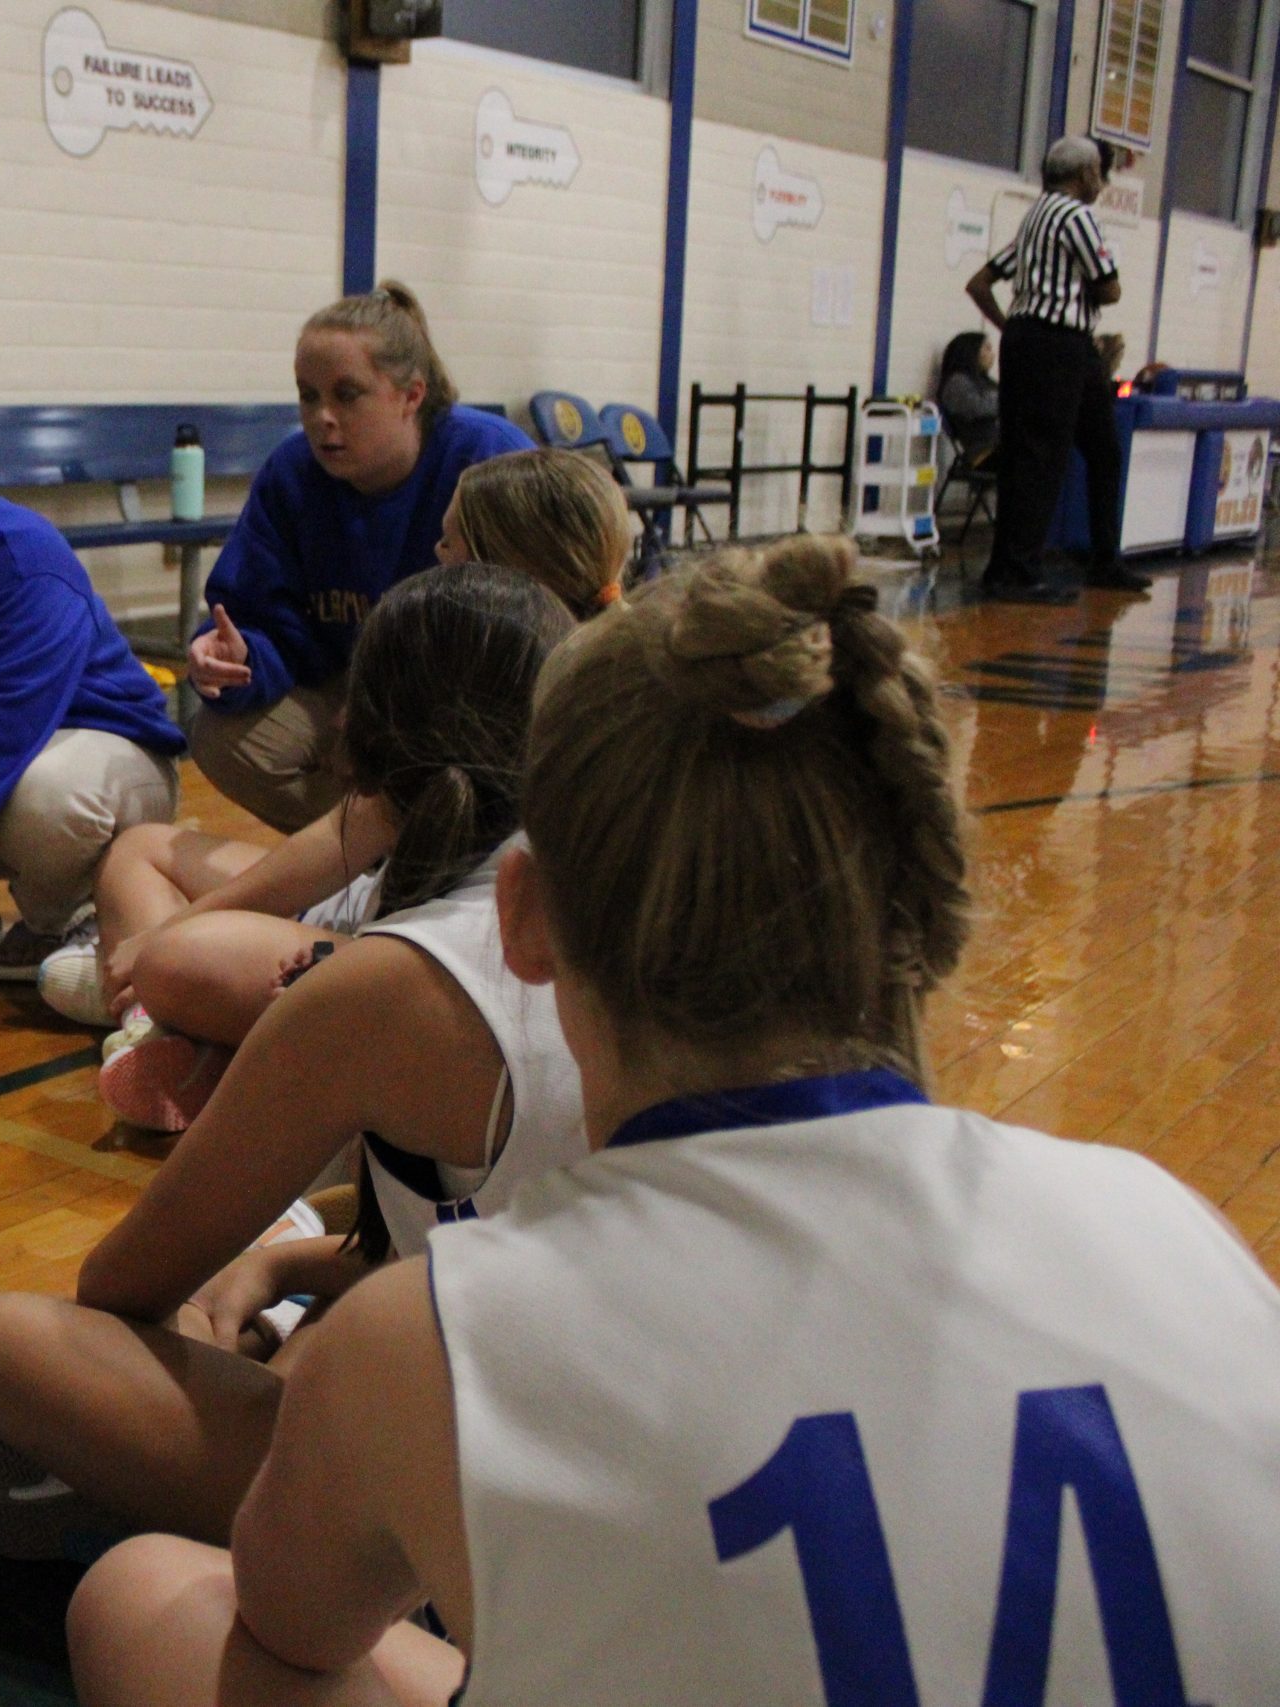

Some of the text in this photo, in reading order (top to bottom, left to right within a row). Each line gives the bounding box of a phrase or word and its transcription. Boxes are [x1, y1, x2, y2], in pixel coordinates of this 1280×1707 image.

[83, 54, 193, 89] FAILURE LEADS
[106, 87, 196, 117] TO SUCCESS
[506, 142, 557, 162] INTEGRITY
[708, 1383, 1214, 1707] 14
